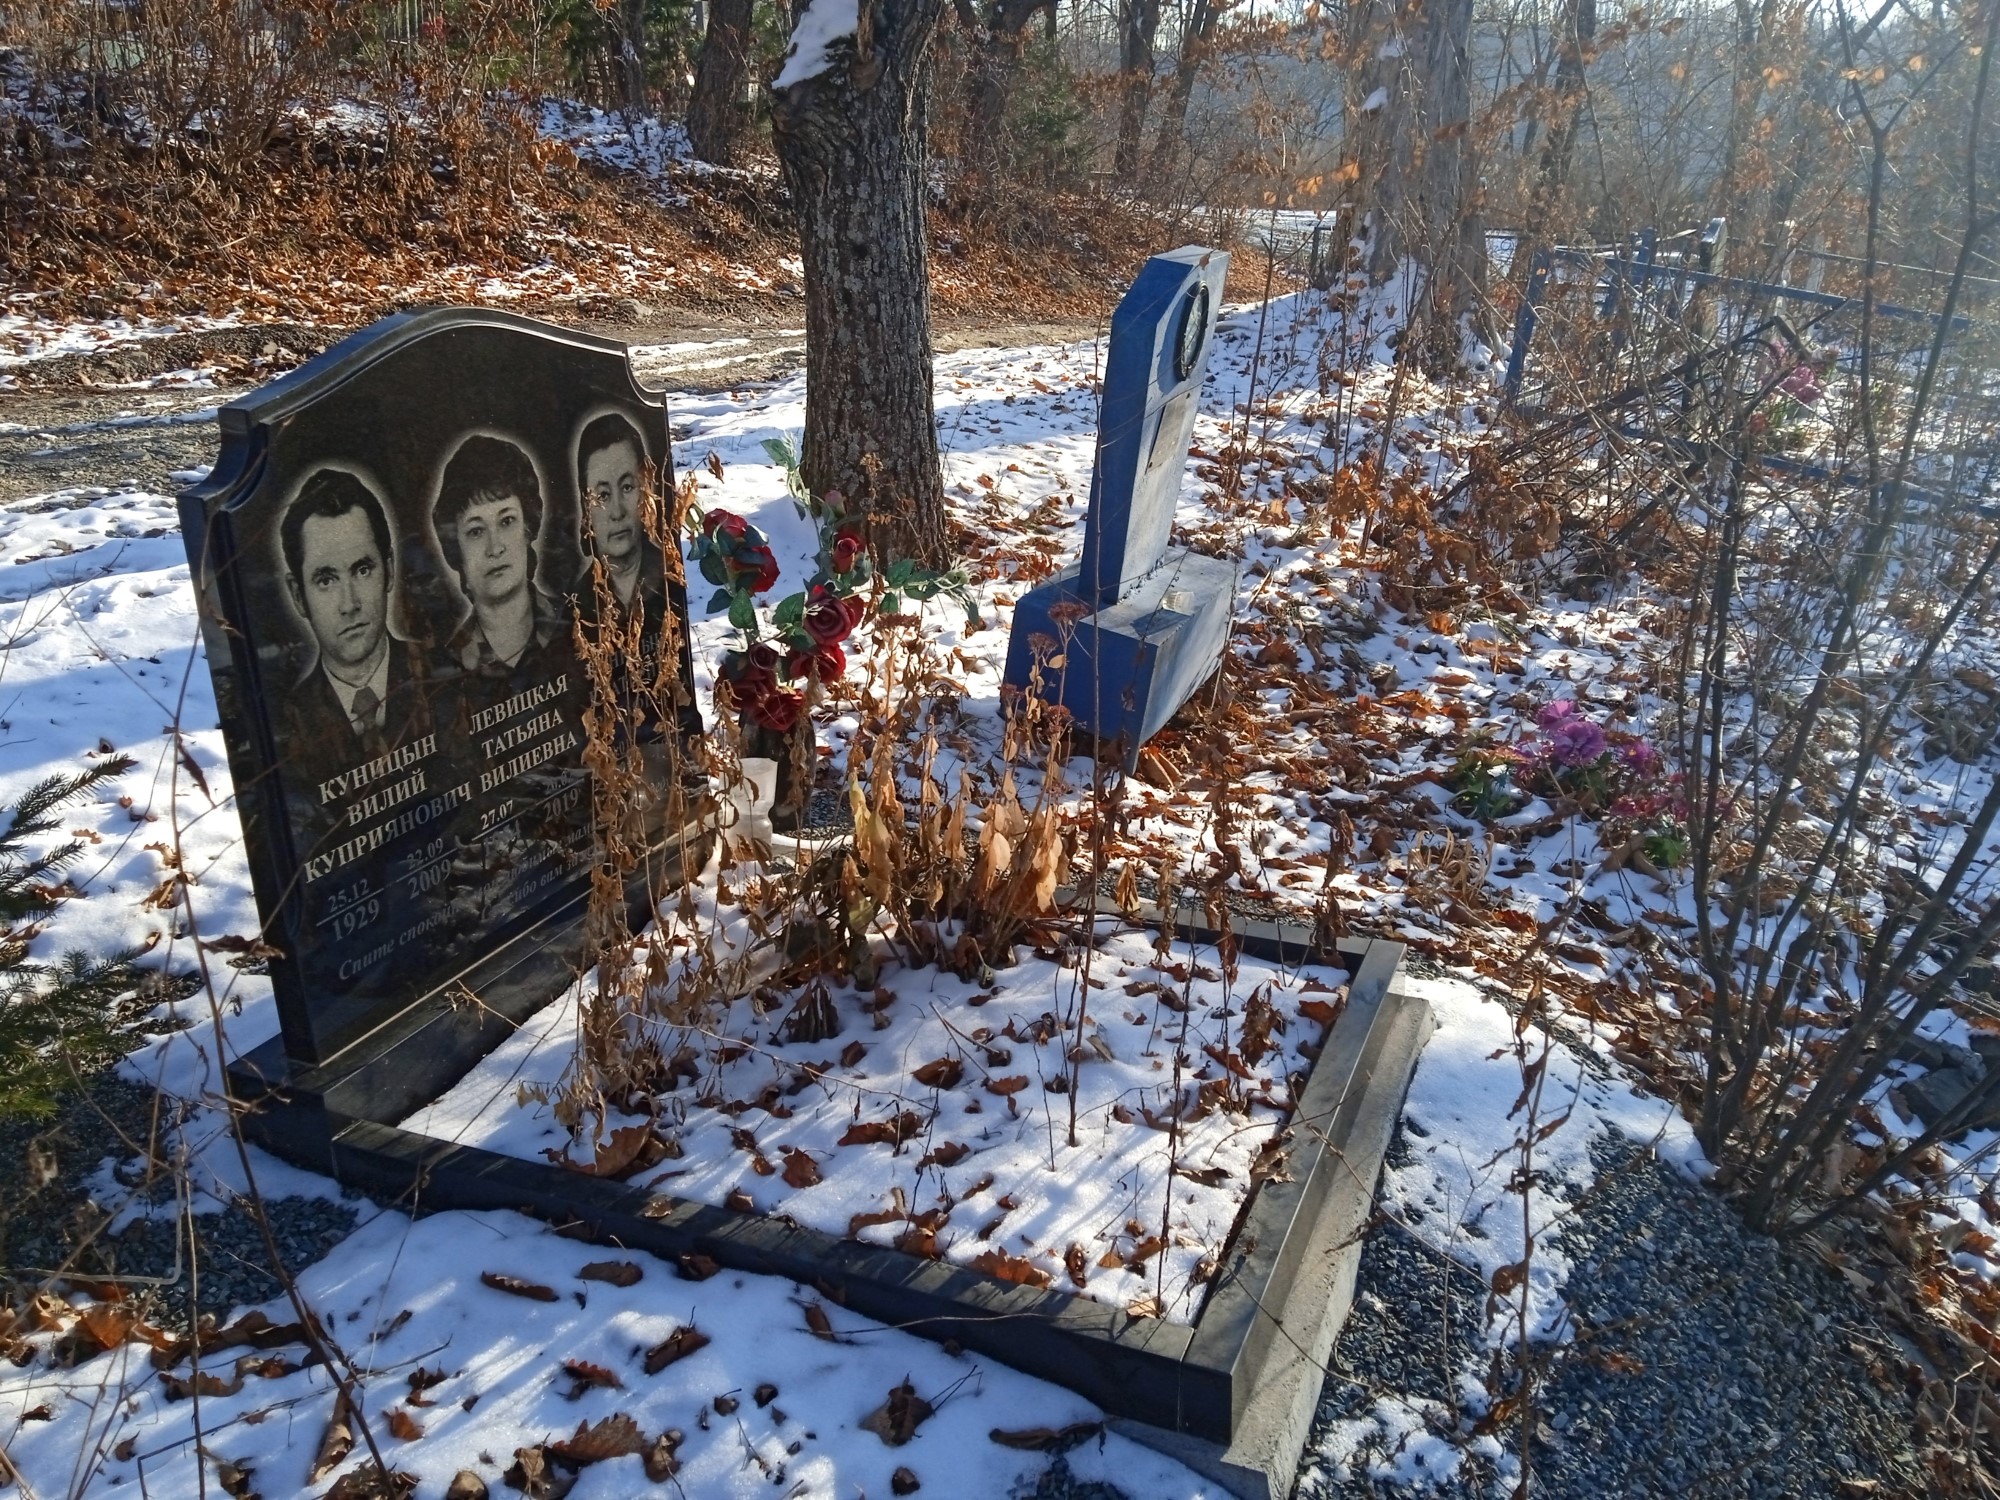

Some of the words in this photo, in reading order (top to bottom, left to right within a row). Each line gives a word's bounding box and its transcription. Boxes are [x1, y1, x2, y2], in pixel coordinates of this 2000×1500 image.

[469, 673, 569, 736] ЛЕВИЦКАЯ
[481, 708, 564, 760] ТАТЬЯНА
[318, 733, 438, 805] КУНИЦЫН
[478, 731, 578, 794] ВИЛИЕВНА
[347, 769, 428, 827] ВИЛИЙ
[480, 799, 514, 831] 27.07
[543, 788, 580, 824] 2019
[303, 781, 472, 884] КУПРИЯНОВИЧ
[328, 878, 370, 913] 25.12
[407, 859, 452, 900] 2009
[331, 899, 380, 942] 1929
[338, 937, 394, 982] Спите
